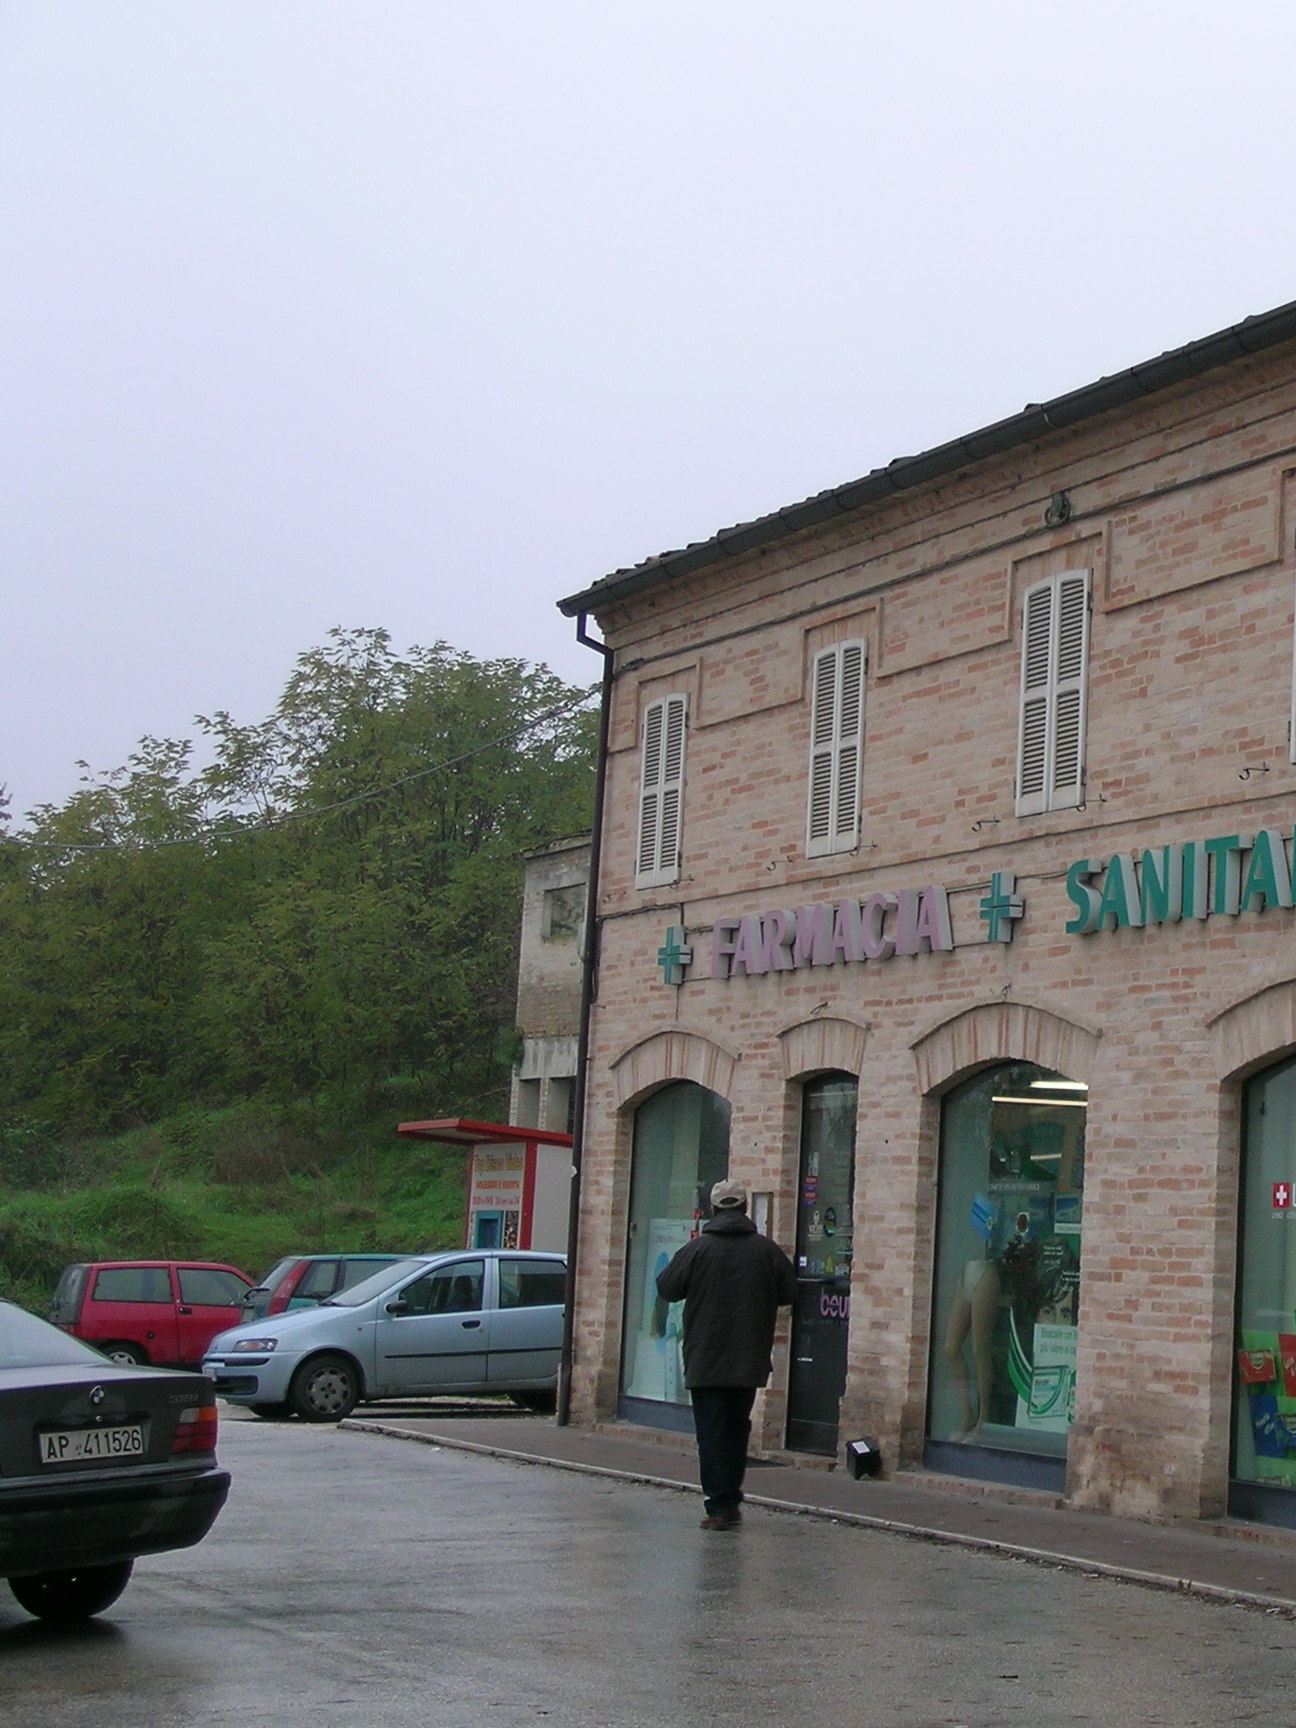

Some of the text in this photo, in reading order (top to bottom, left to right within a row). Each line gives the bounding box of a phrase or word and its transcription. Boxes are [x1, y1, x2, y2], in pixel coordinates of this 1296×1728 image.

[711, 885, 954, 979] FARMACIA
[47, 1428, 142, 1460] AP 411526
